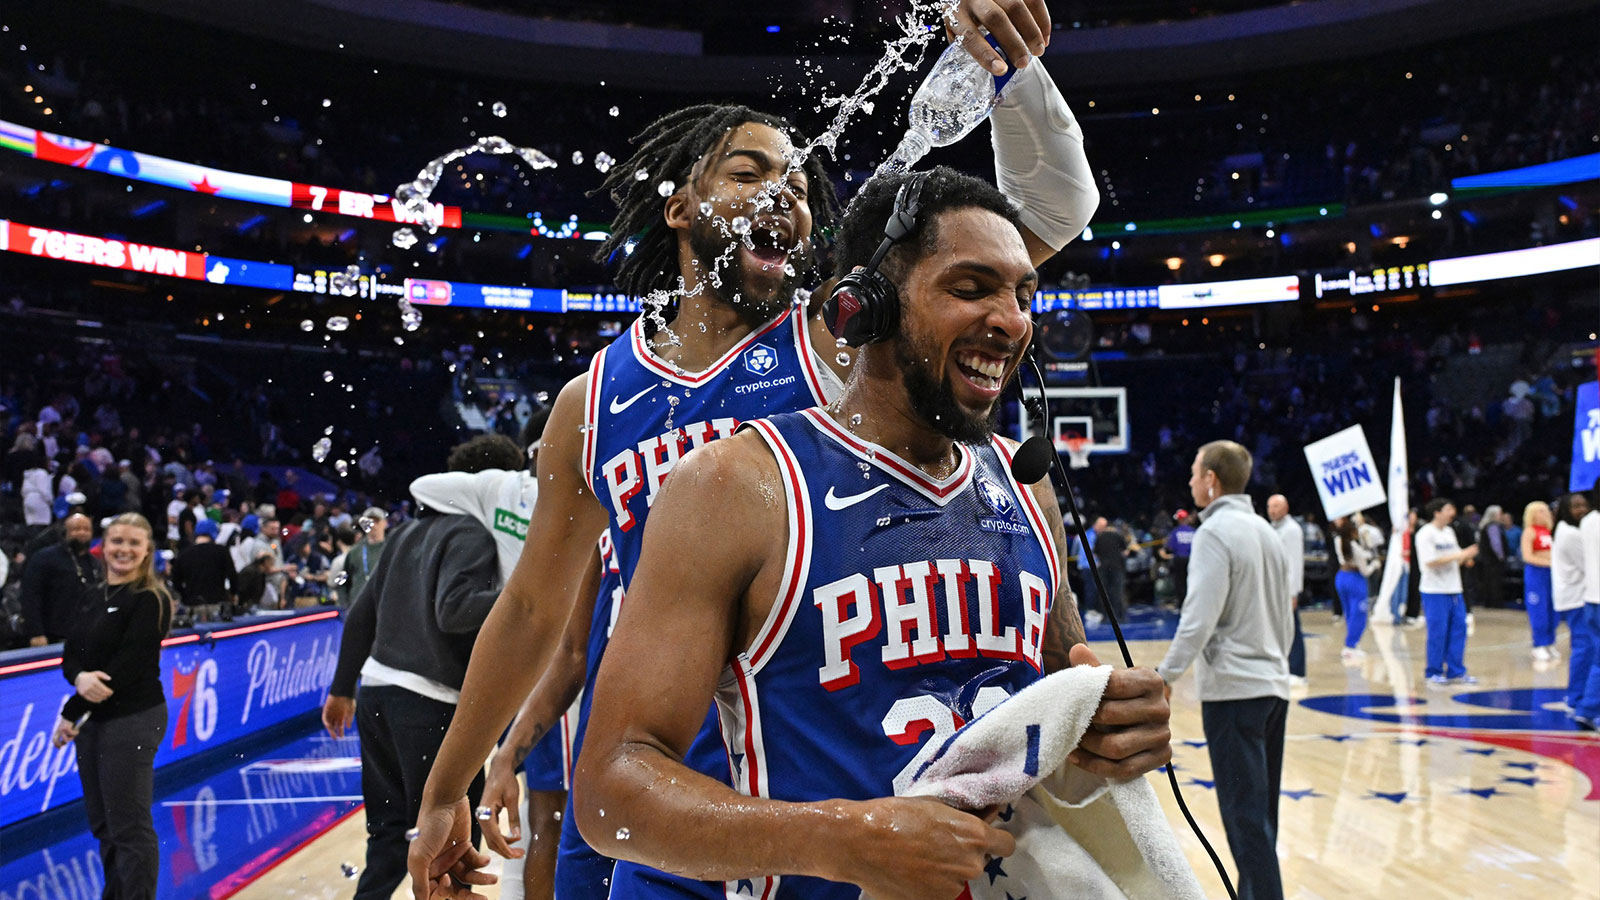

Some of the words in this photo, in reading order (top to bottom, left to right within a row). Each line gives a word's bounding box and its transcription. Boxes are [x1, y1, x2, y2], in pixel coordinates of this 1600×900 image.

[28, 226, 126, 268] 76ERS
[128, 243, 187, 277] WIN
[735, 375, 796, 394] crypto.com
[602, 417, 741, 533] PH
[1322, 461, 1372, 497] WIN
[981, 519, 1030, 535] crypto.com
[172, 658, 219, 750] 76
[0, 693, 78, 812] delp
